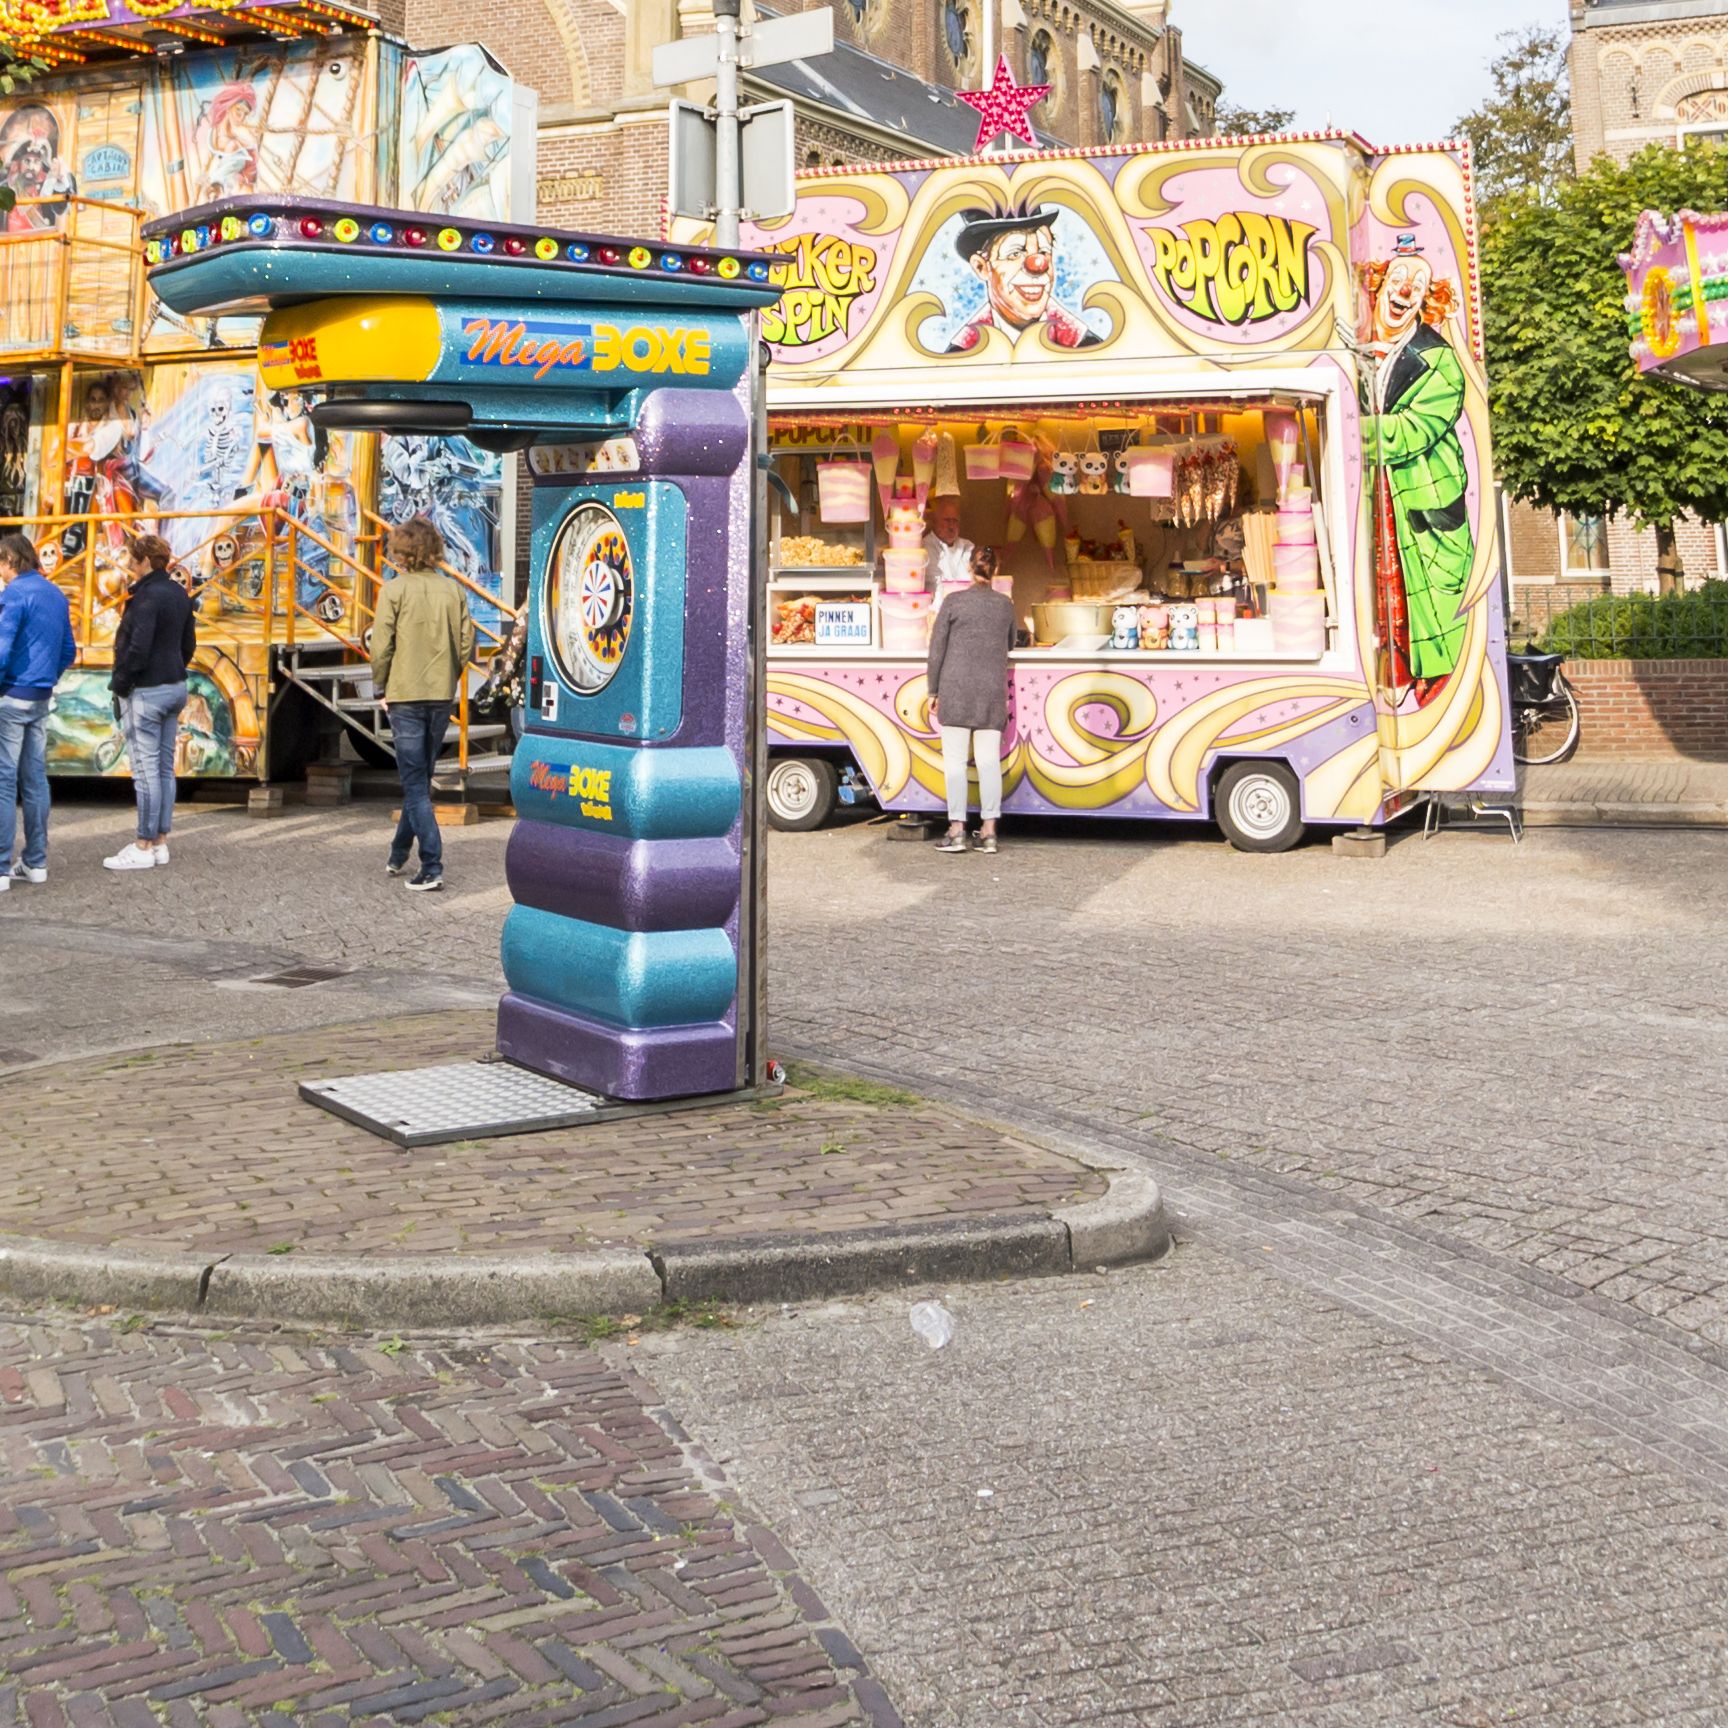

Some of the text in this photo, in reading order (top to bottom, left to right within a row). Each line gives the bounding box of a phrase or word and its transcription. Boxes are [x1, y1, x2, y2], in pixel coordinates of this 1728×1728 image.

[1140, 211, 1320, 326] POPCORN
[463, 318, 711, 381] Mega BOXE
[818, 610, 854, 623] PINNEN
[818, 625, 867, 638] JA GRAAG
